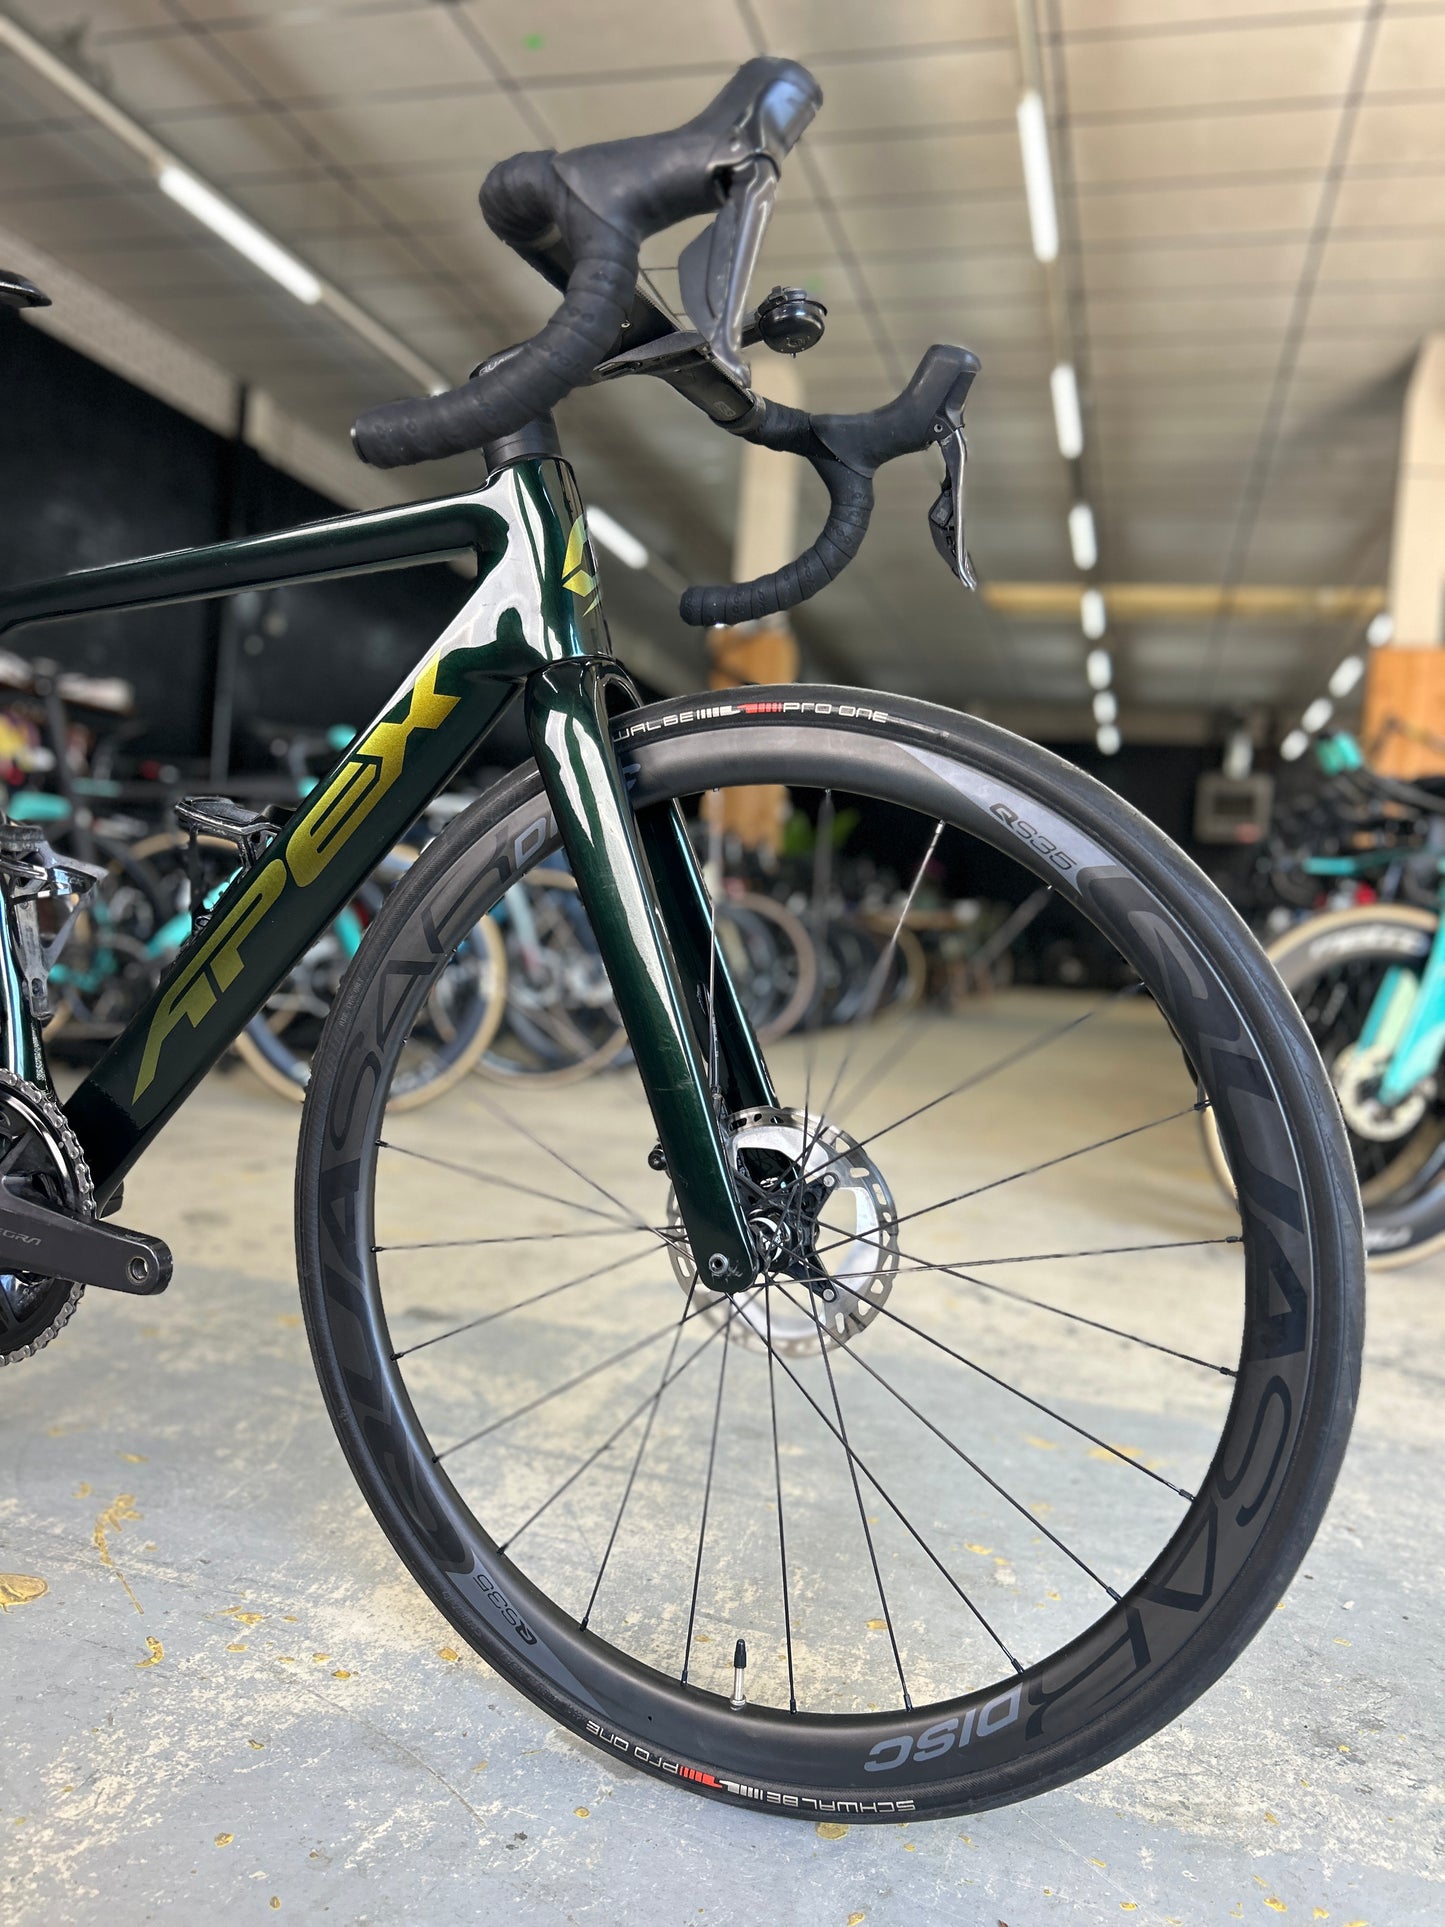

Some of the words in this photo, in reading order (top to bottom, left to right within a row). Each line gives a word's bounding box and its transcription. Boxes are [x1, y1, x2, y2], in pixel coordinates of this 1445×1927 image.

[989, 803, 1078, 870] QS35
[132, 648, 461, 1106] APEX
[472, 1574, 538, 1646] QS35
[863, 1682, 1024, 1773] DISC
[766, 1791, 916, 1813] SCHWALBE
